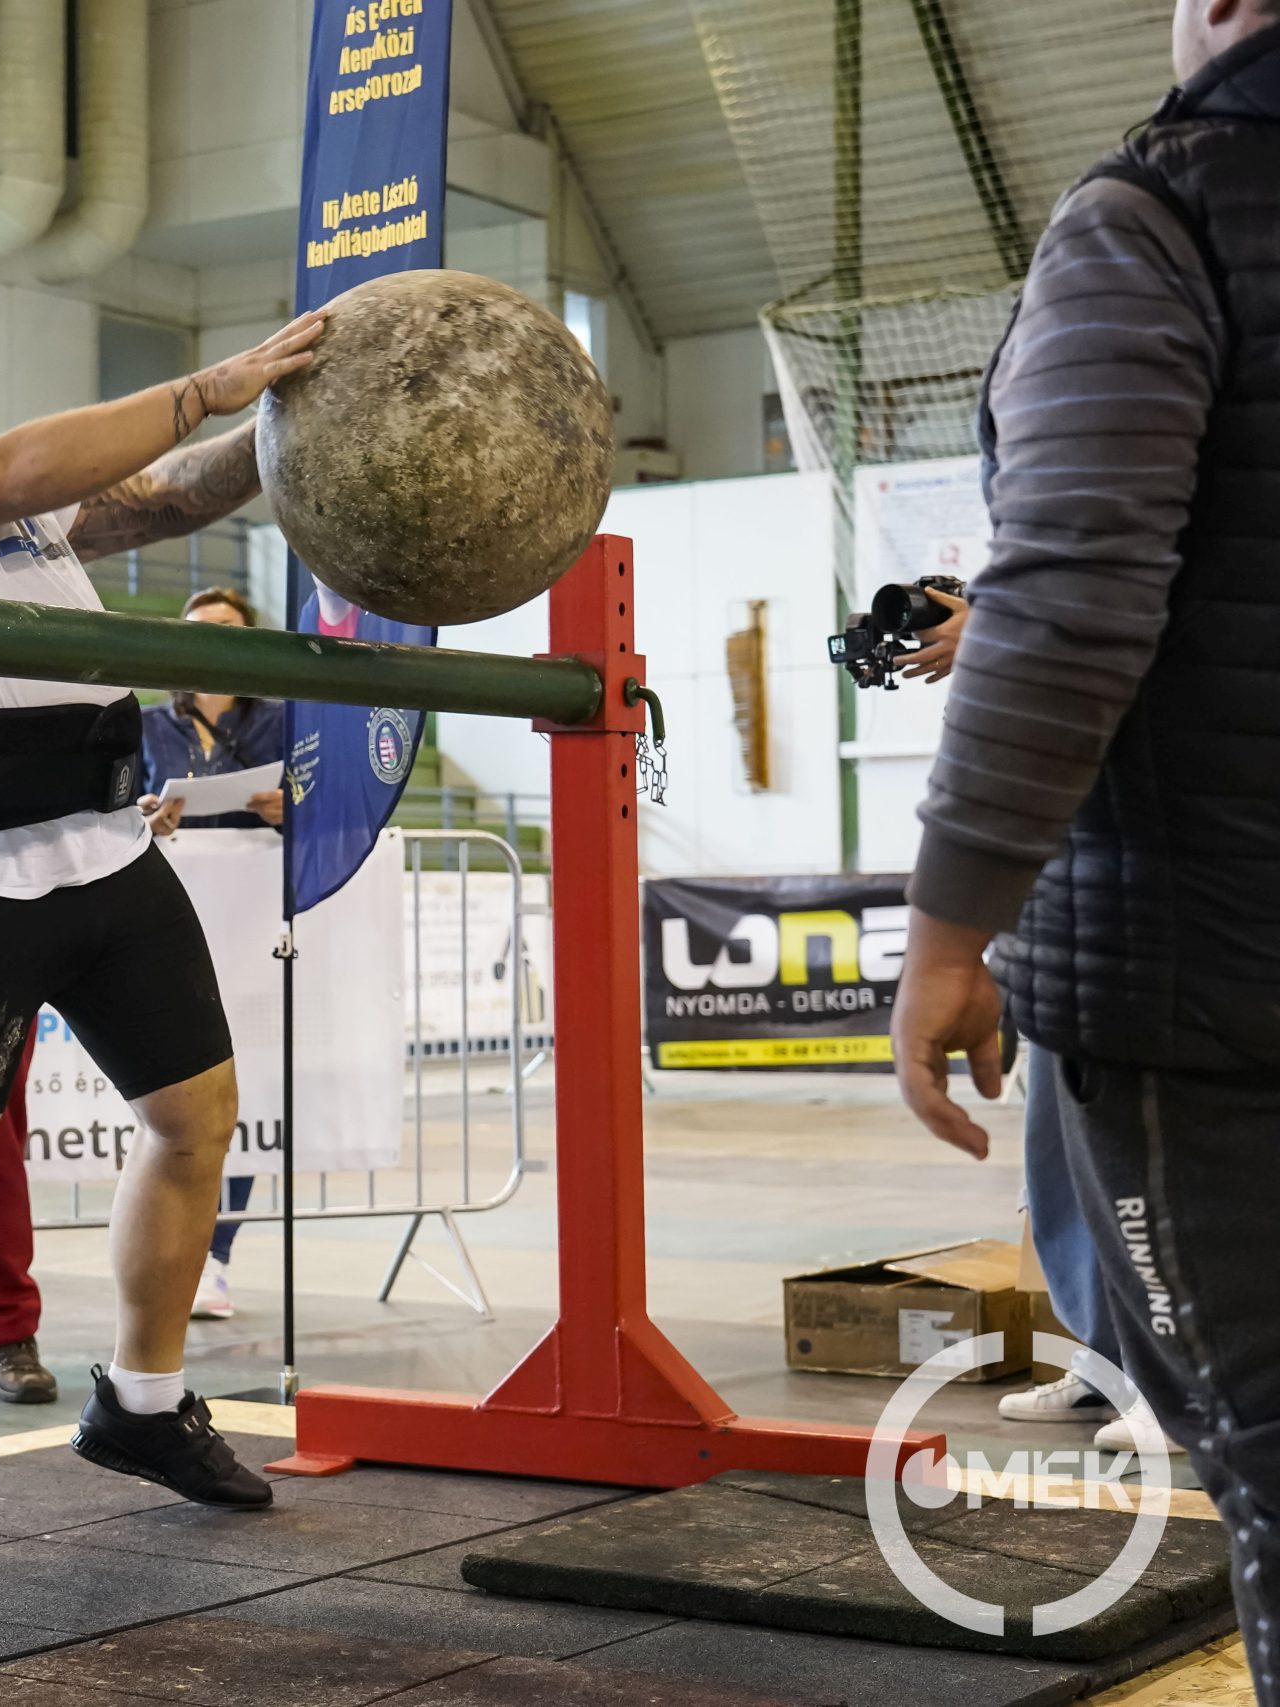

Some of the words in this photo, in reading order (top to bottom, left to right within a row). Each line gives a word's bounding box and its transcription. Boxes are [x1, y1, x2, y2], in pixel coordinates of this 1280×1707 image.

[666, 993, 770, 1017] NYOMDA
[792, 988, 875, 1013] DEKOR
[75, 1071, 108, 1098] ép
[1115, 1196, 1177, 1337] RUNNING
